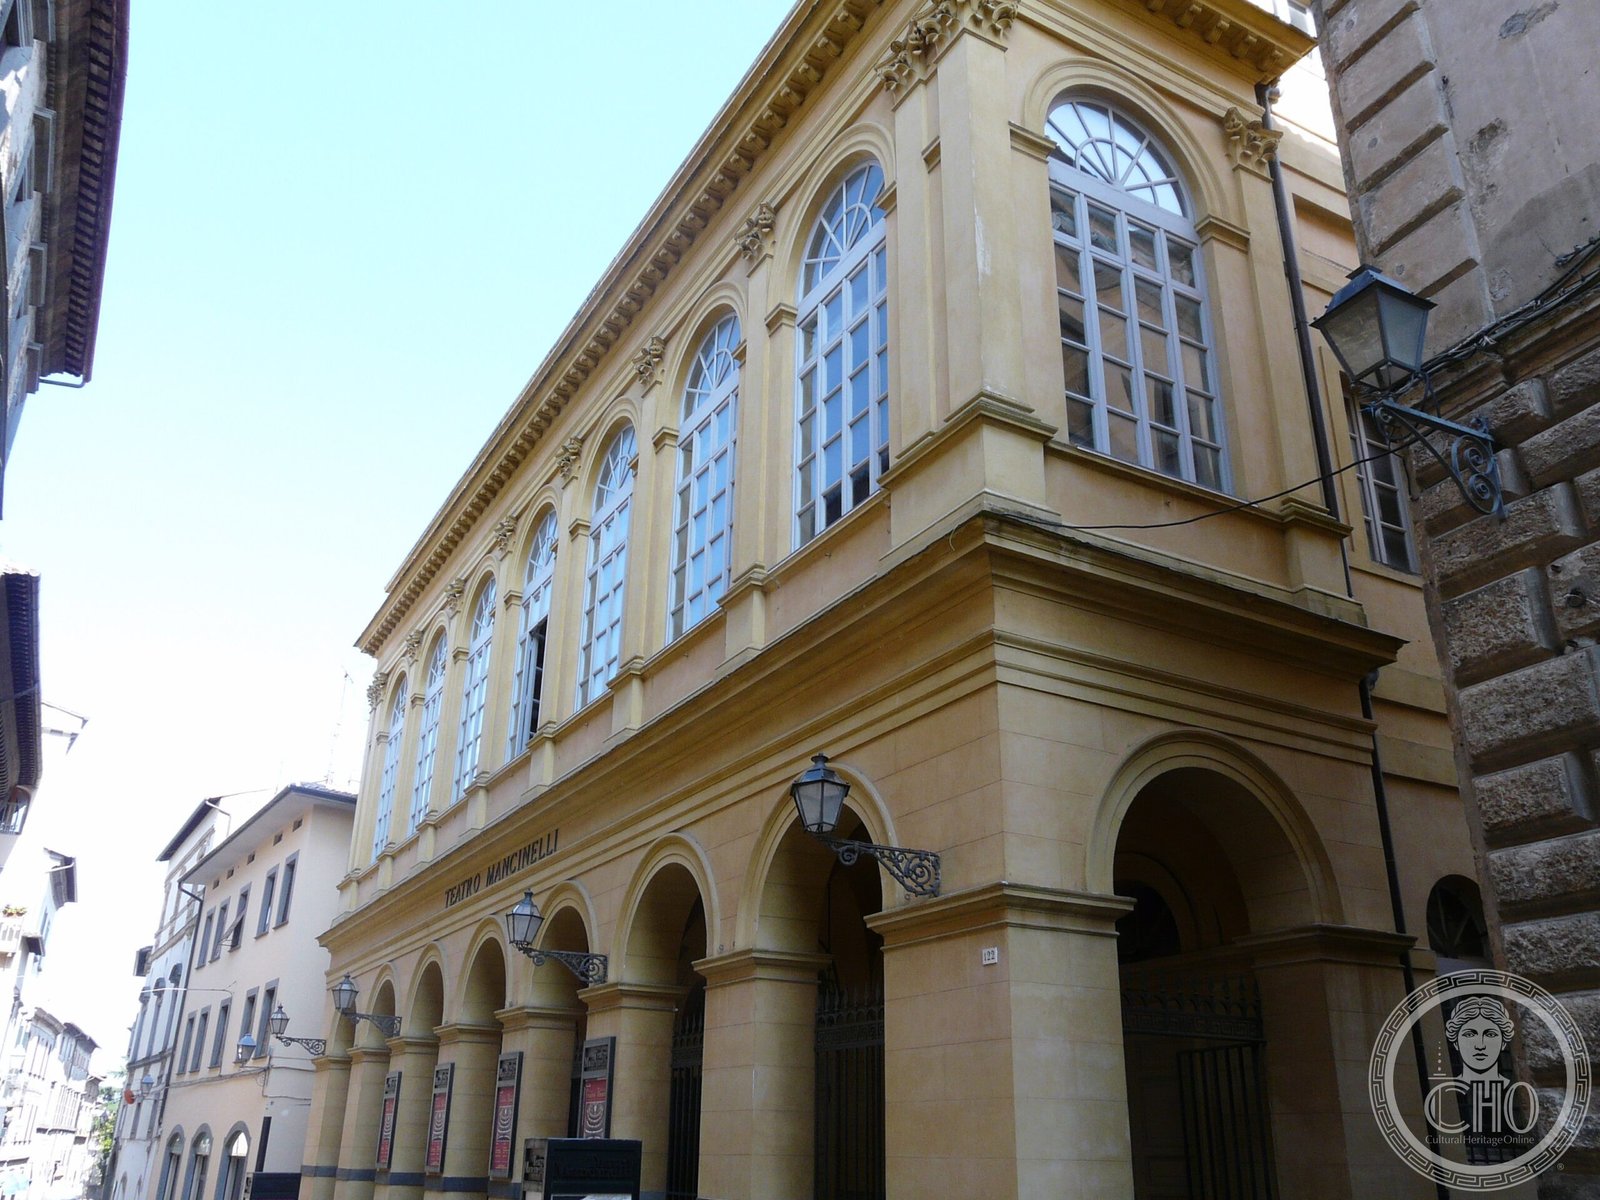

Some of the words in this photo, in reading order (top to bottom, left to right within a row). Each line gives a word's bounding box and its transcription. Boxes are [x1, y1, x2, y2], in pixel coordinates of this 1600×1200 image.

[445, 873, 480, 908] TEATRO
[486, 829, 559, 887] MANCINELLI
[984, 950, 995, 962] 122
